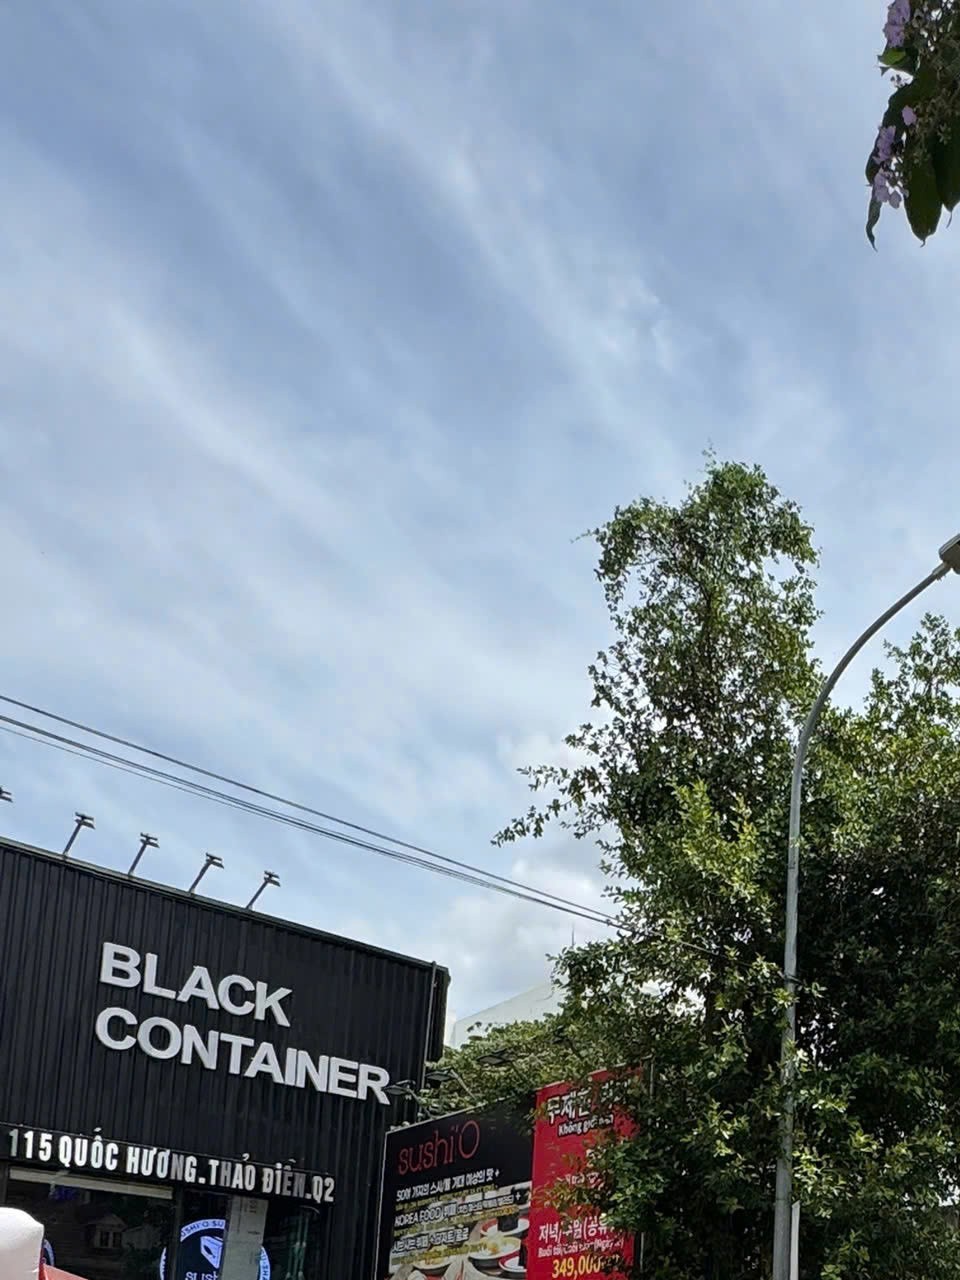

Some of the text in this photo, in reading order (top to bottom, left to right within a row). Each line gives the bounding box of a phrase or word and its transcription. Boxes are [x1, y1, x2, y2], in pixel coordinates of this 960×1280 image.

[100, 941, 293, 1028] BLACK
[95, 1006, 391, 1106] CONTAINER
[8, 1128, 53, 1163] 115
[58, 1126, 119, 1171] QUỐC
